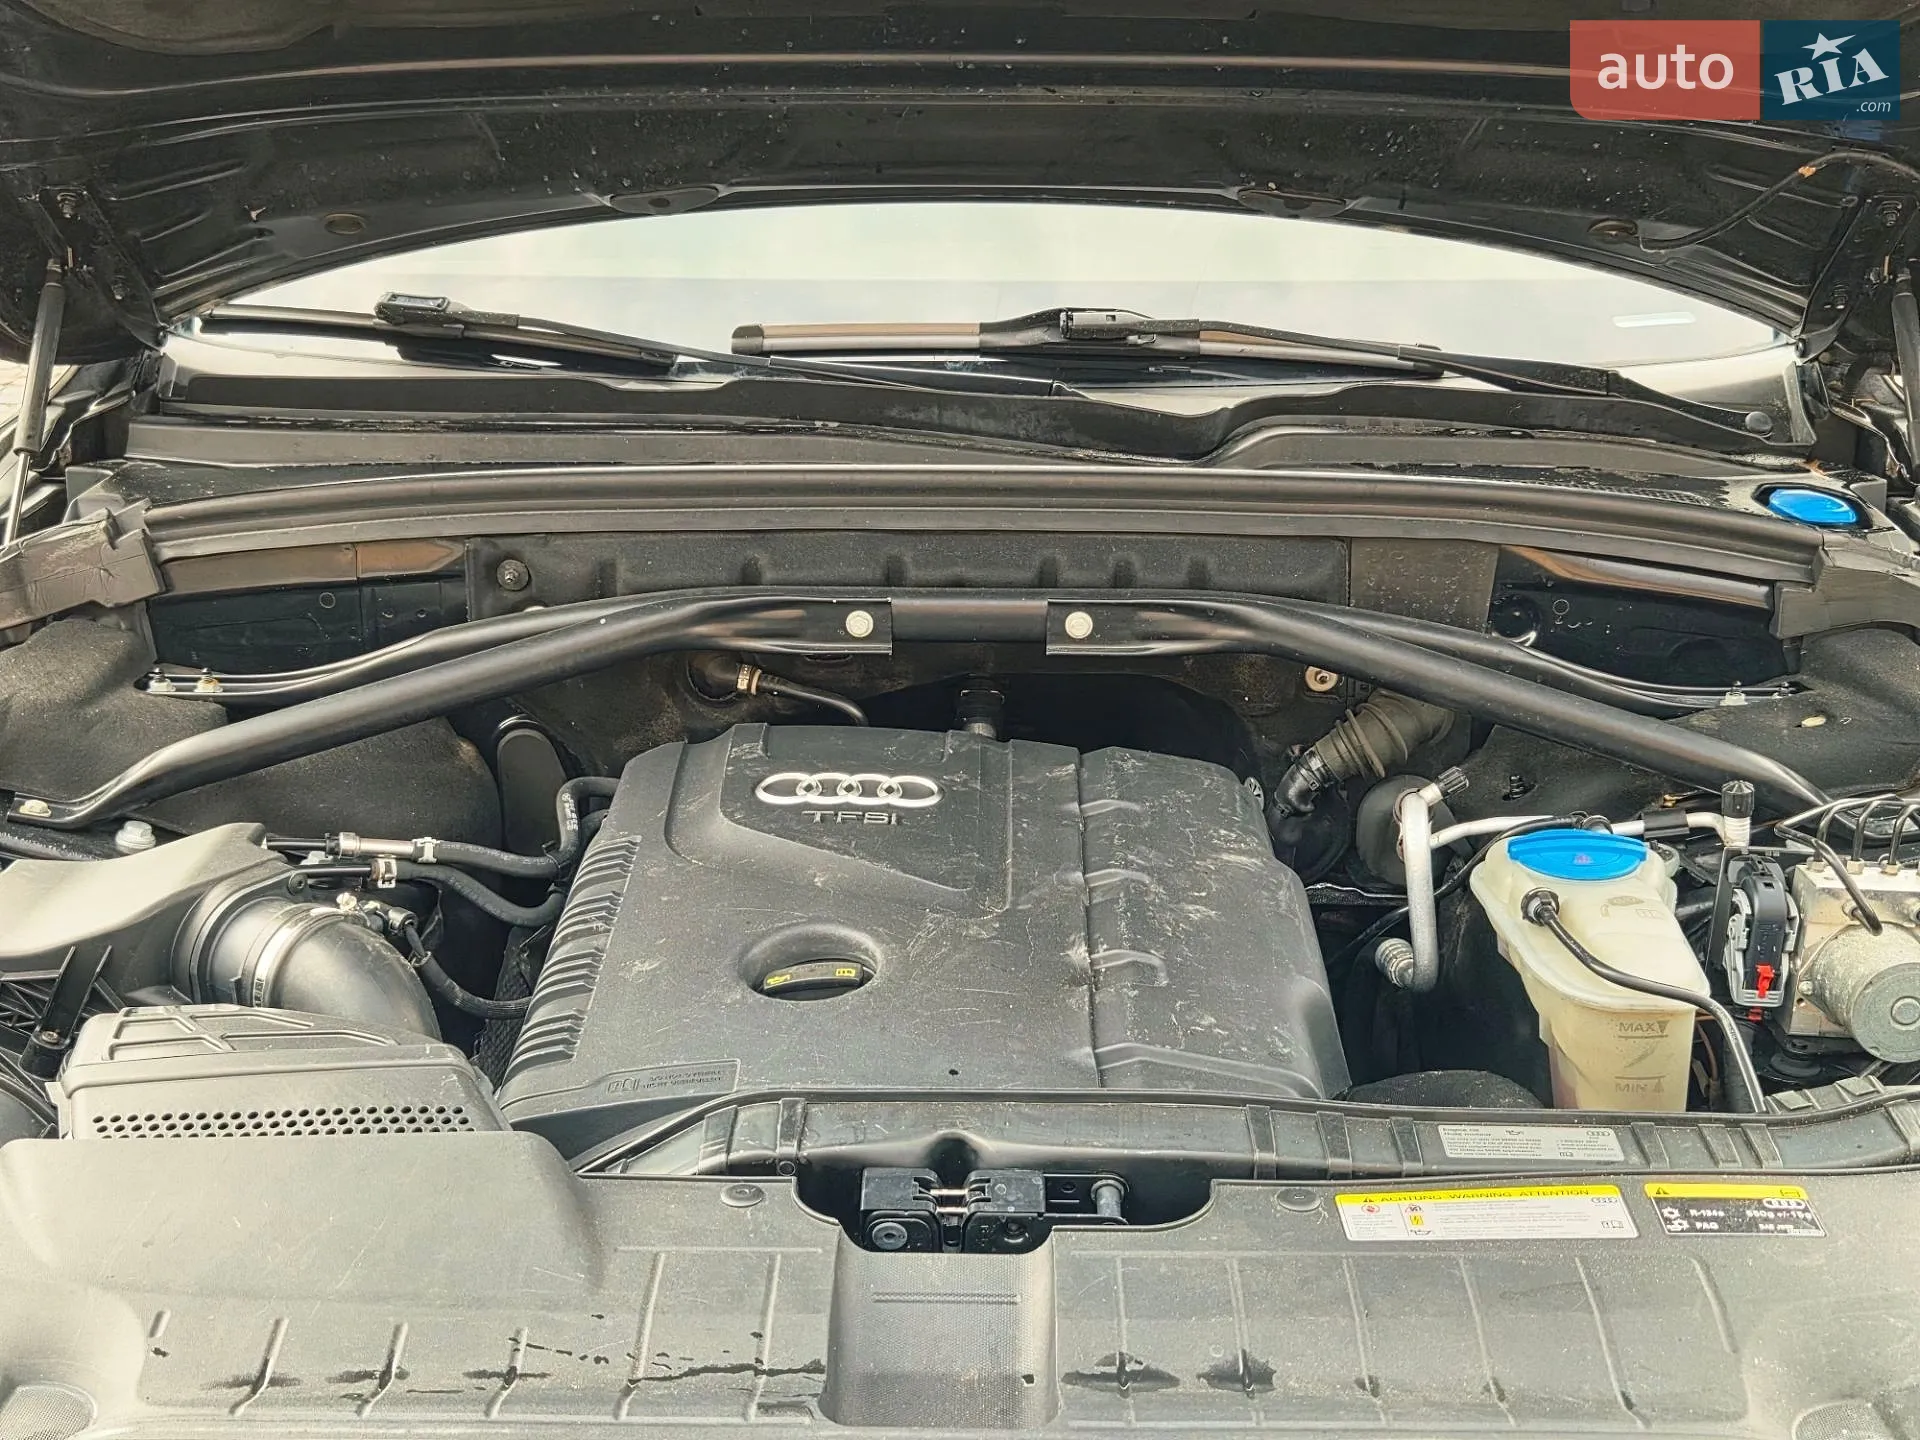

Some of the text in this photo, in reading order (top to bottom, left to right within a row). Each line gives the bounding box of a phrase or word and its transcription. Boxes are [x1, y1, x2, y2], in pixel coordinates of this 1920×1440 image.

[802, 809, 898, 826] TFSI
[1618, 1021, 1657, 1034] MAX
[1615, 1082, 1648, 1094] MIN
[1380, 1188, 1590, 1203] ACHTUNG WARNING ATTENTION
